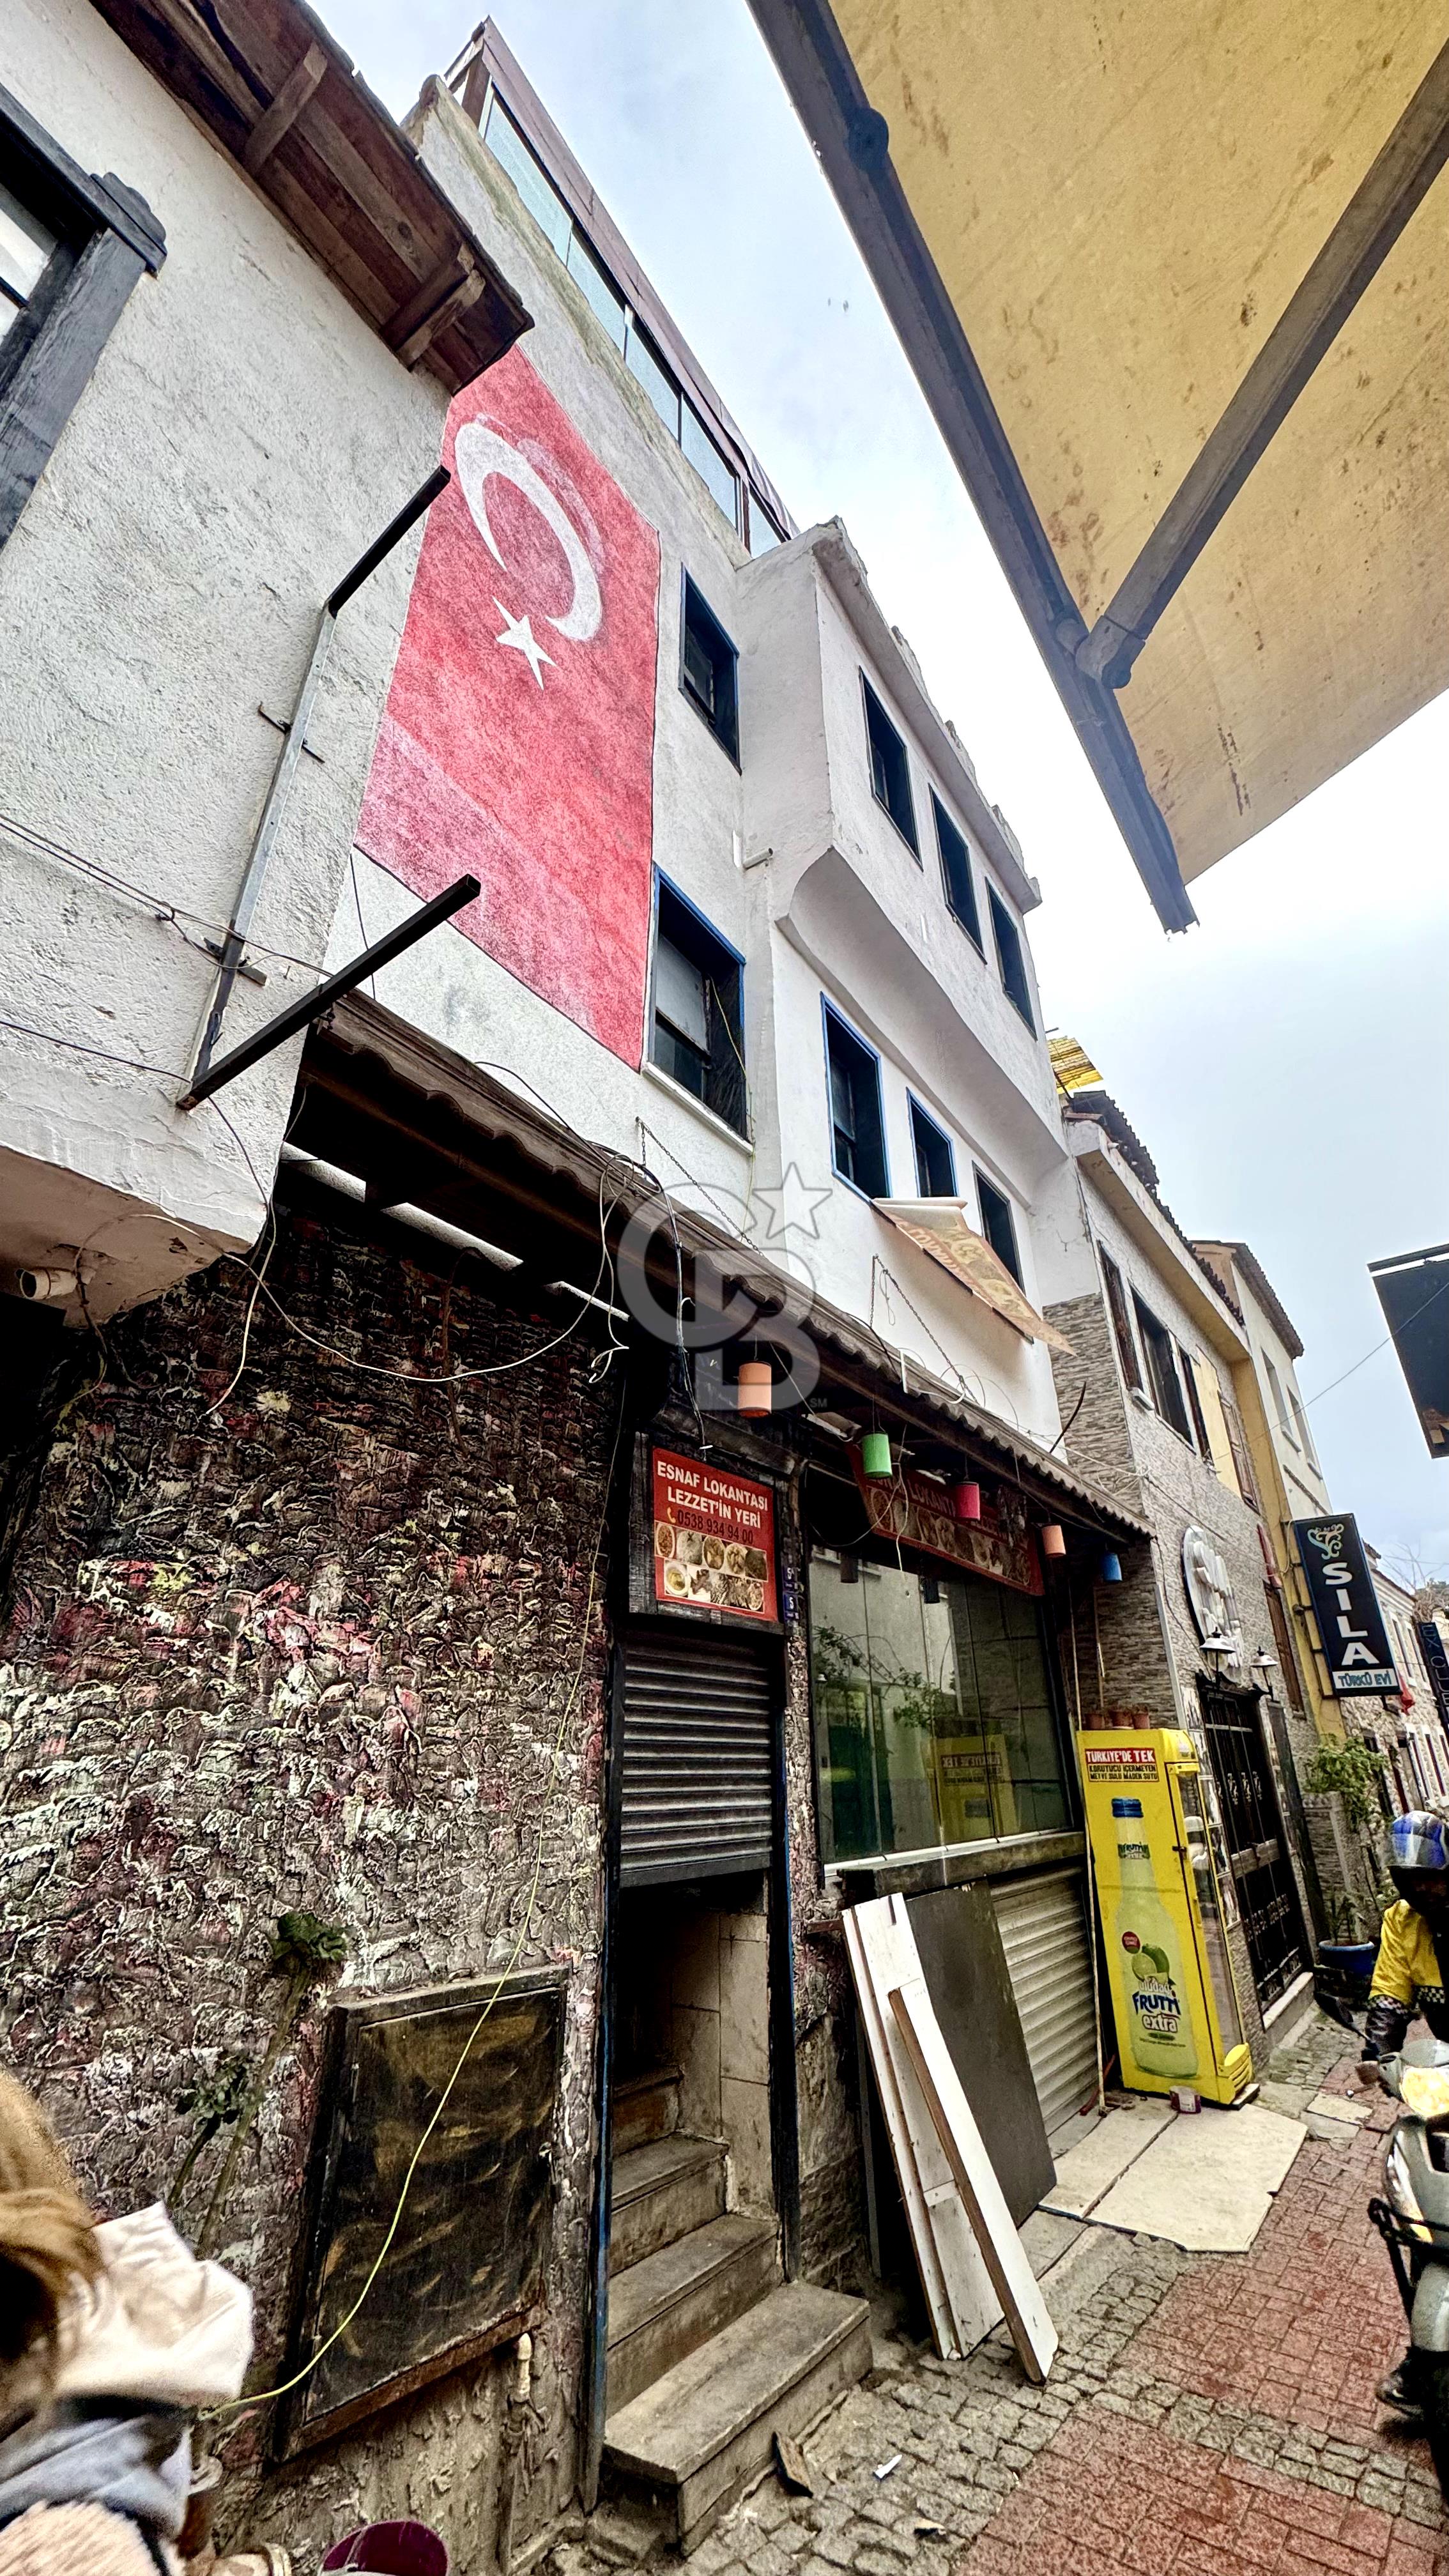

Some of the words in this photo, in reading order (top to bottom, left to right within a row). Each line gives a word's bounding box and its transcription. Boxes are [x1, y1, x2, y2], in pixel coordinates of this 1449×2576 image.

[657, 1460, 700, 1488] ESNAF
[703, 1476, 768, 1511] LOKANTASI
[668, 1486, 732, 1520] LEZZET'İN
[735, 1507, 761, 1529] YERİ
[677, 1509, 703, 1530] 0538
[707, 1518, 725, 1536] 934
[727, 1524, 739, 1541] 94
[742, 1529, 753, 1544] 00
[1322, 1562, 1380, 1666] SILA
[1338, 1673, 1373, 1687] TÜRKÜ
[1374, 1669, 1392, 1685] EVİ
[1133, 1750, 1155, 1763] TEK
[1144, 2015, 1176, 2032] extra
